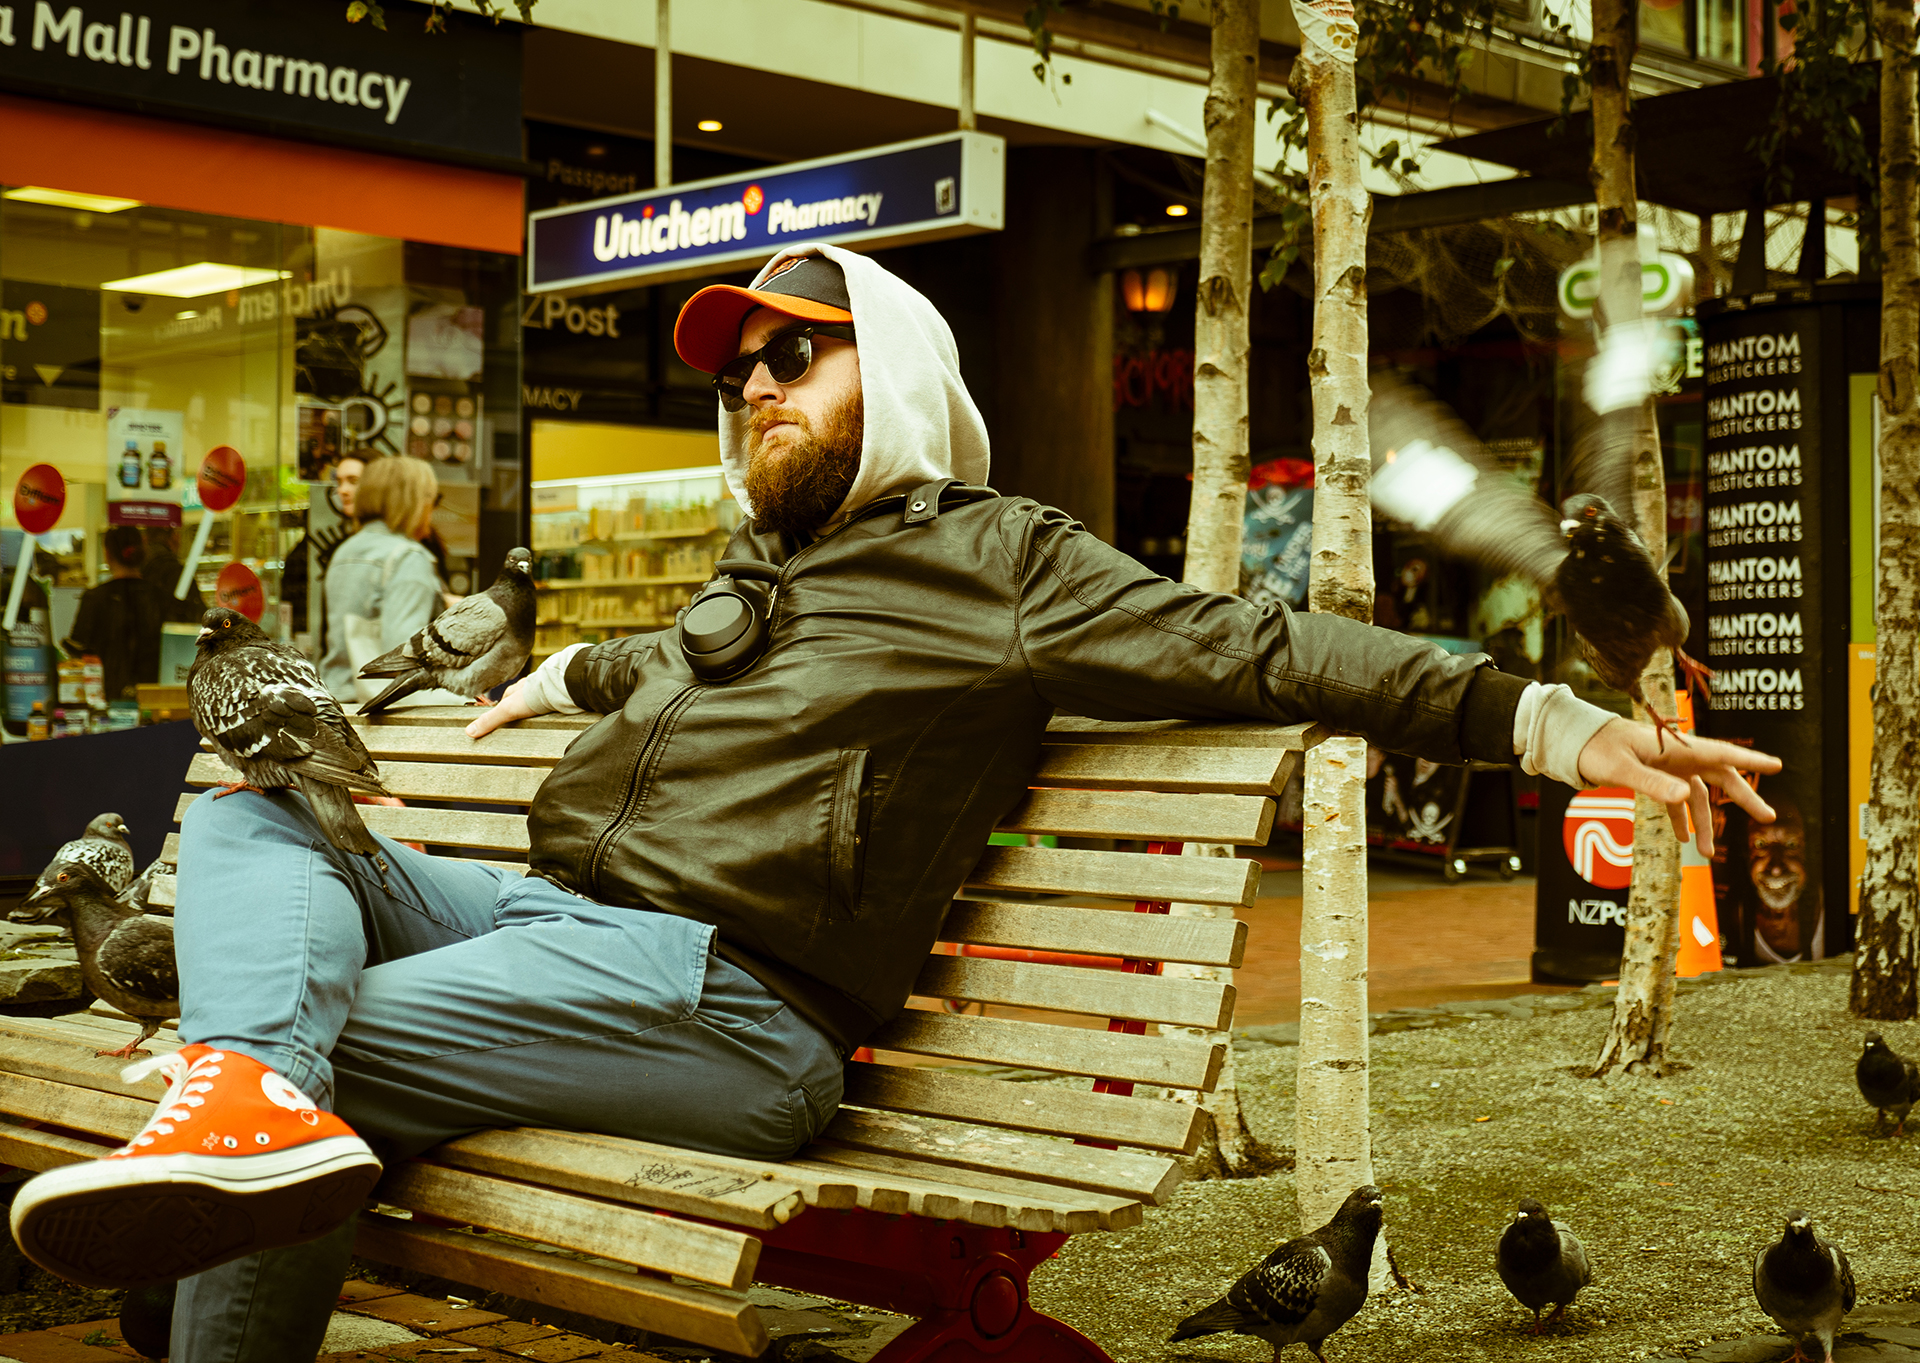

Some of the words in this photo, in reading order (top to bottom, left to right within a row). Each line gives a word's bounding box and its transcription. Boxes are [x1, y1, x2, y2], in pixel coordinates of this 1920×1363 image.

[31, 0, 152, 70] Mall
[166, 24, 412, 125] Pharmacy
[592, 198, 748, 263] Unichem
[766, 191, 884, 236] Pharmacy
